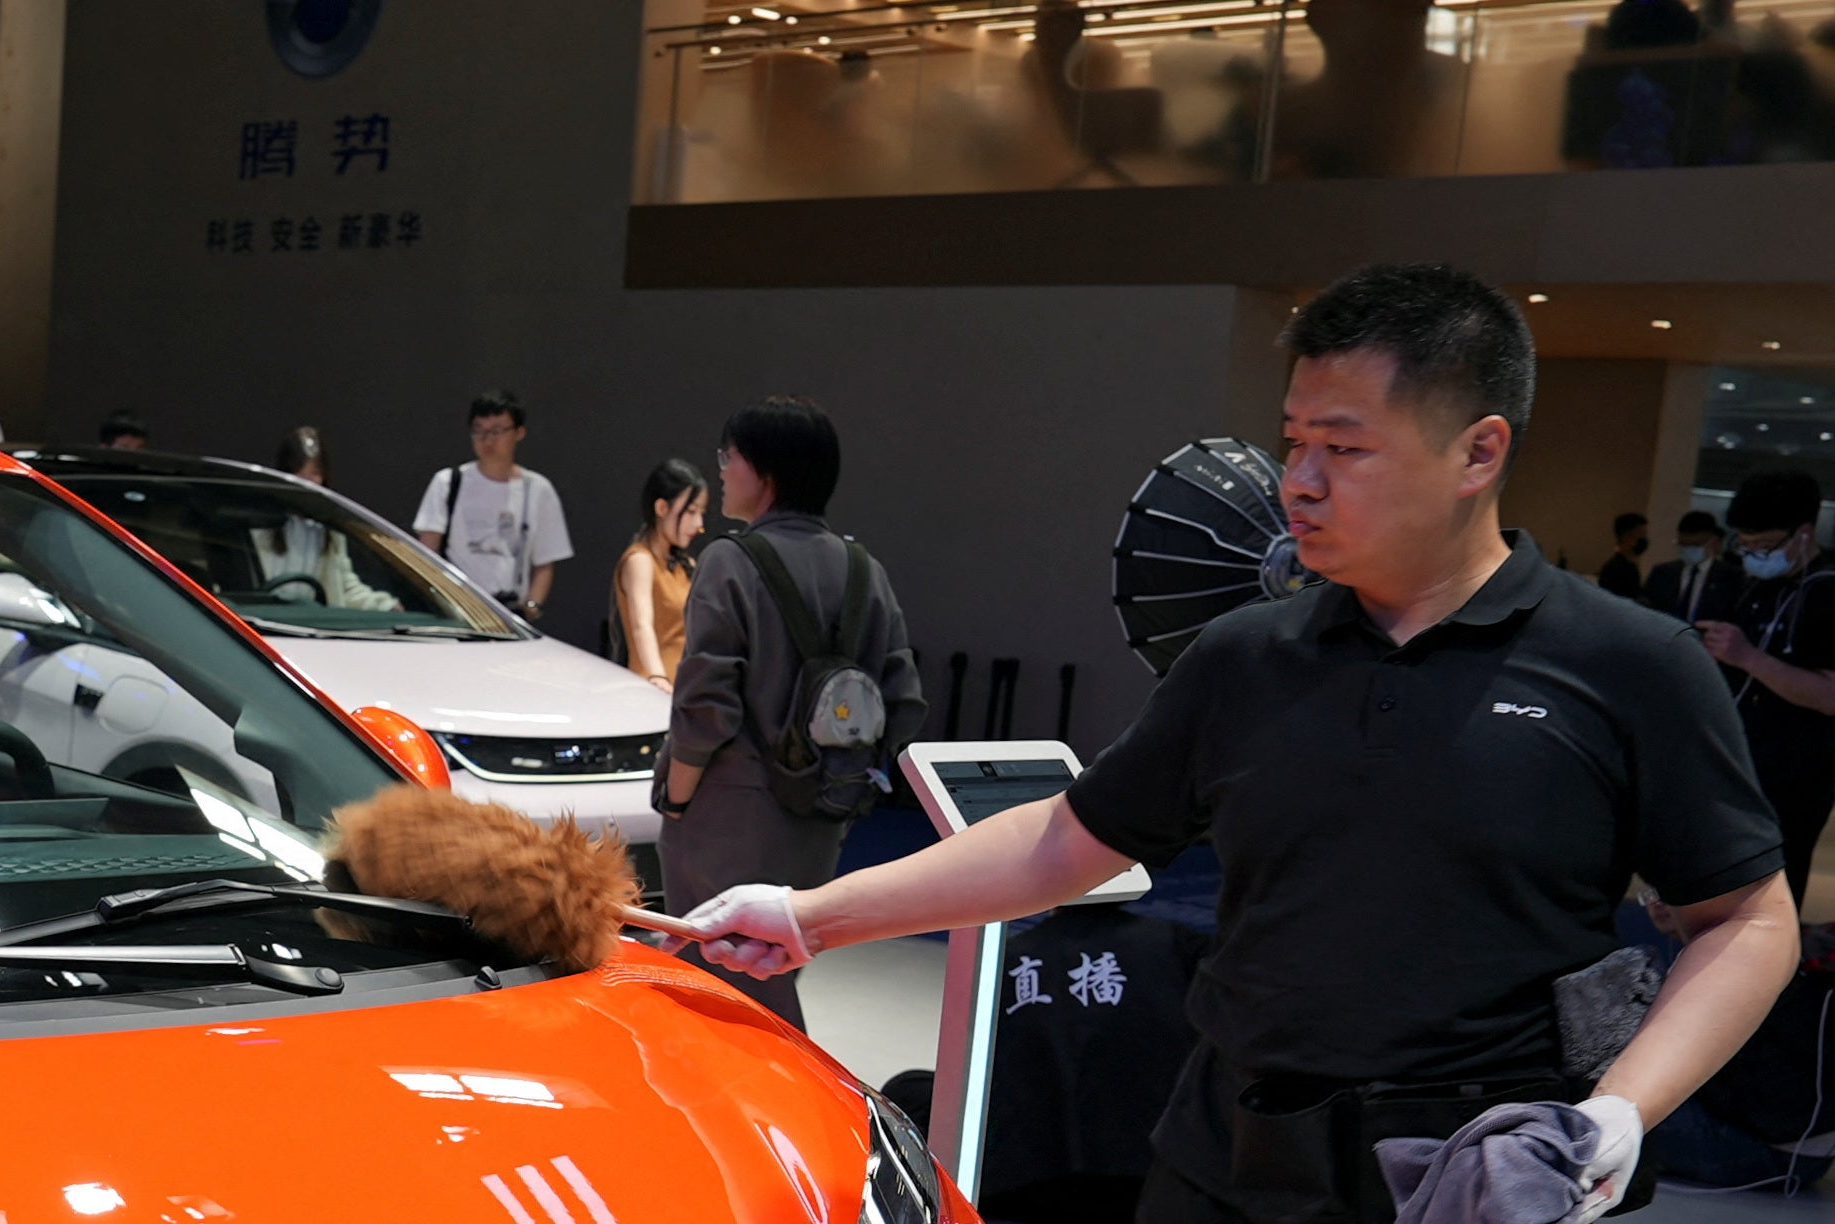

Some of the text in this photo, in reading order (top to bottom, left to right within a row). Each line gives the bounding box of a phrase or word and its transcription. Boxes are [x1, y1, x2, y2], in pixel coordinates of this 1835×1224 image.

[239, 113, 391, 180] 腾势
[206, 211, 422, 253] 科技 安全 新豪华
[1492, 702, 1548, 719] BYD
[1005, 952, 1128, 1015] 直播
